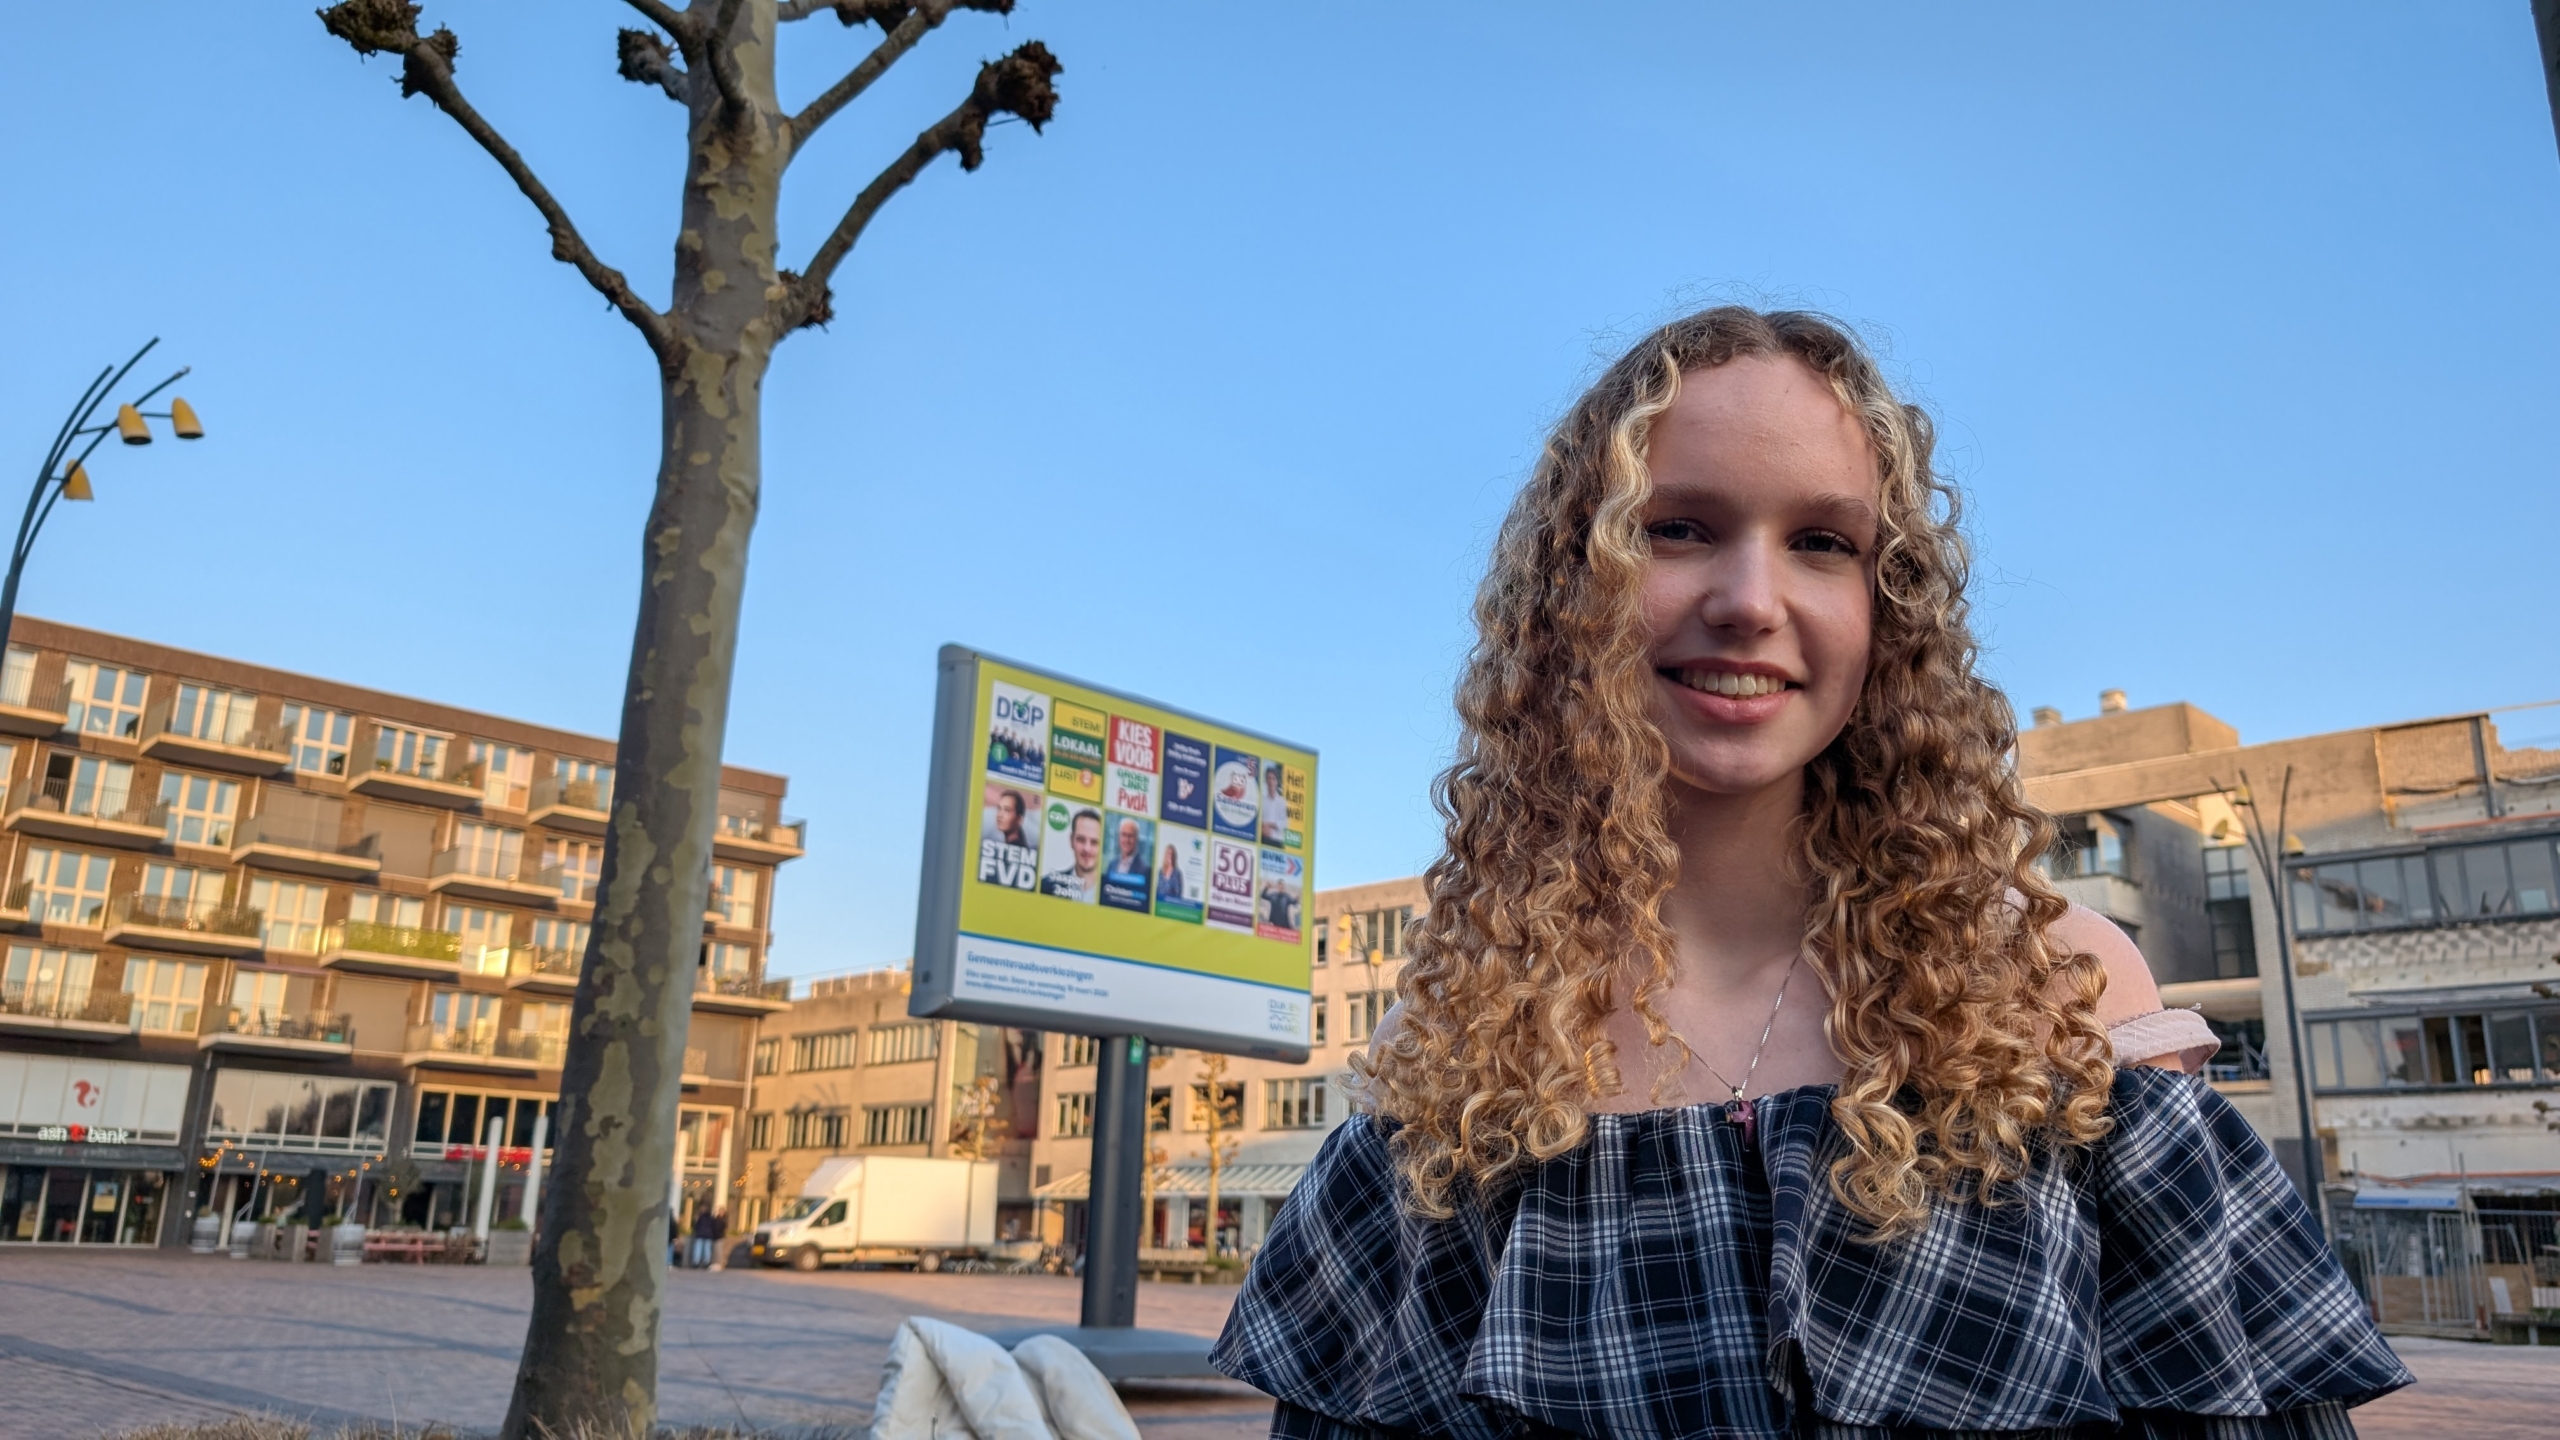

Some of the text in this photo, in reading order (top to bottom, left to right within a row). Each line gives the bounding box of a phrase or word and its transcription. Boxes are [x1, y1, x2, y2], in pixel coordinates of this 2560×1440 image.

[1118, 717, 1152, 748] KIES
[1053, 733, 1103, 758] LOKAAL
[1115, 739, 1154, 771] VOOR
[1117, 767, 1149, 784] GROEN
[1247, 757, 1257, 777] 5
[1122, 777, 1148, 793] LINKS
[1287, 769, 1305, 788] Het
[1118, 787, 1148, 813] PvdA
[1286, 787, 1304, 805] kan
[1286, 805, 1304, 821] wel
[981, 839, 1037, 867] STEM
[1217, 846, 1247, 877] 50
[979, 856, 1036, 890] FVD
[1216, 873, 1247, 893] PLUS
[966, 951, 1095, 982] Gemeenteraadsverkiezingen
[38, 1125, 129, 1144] asn bank
